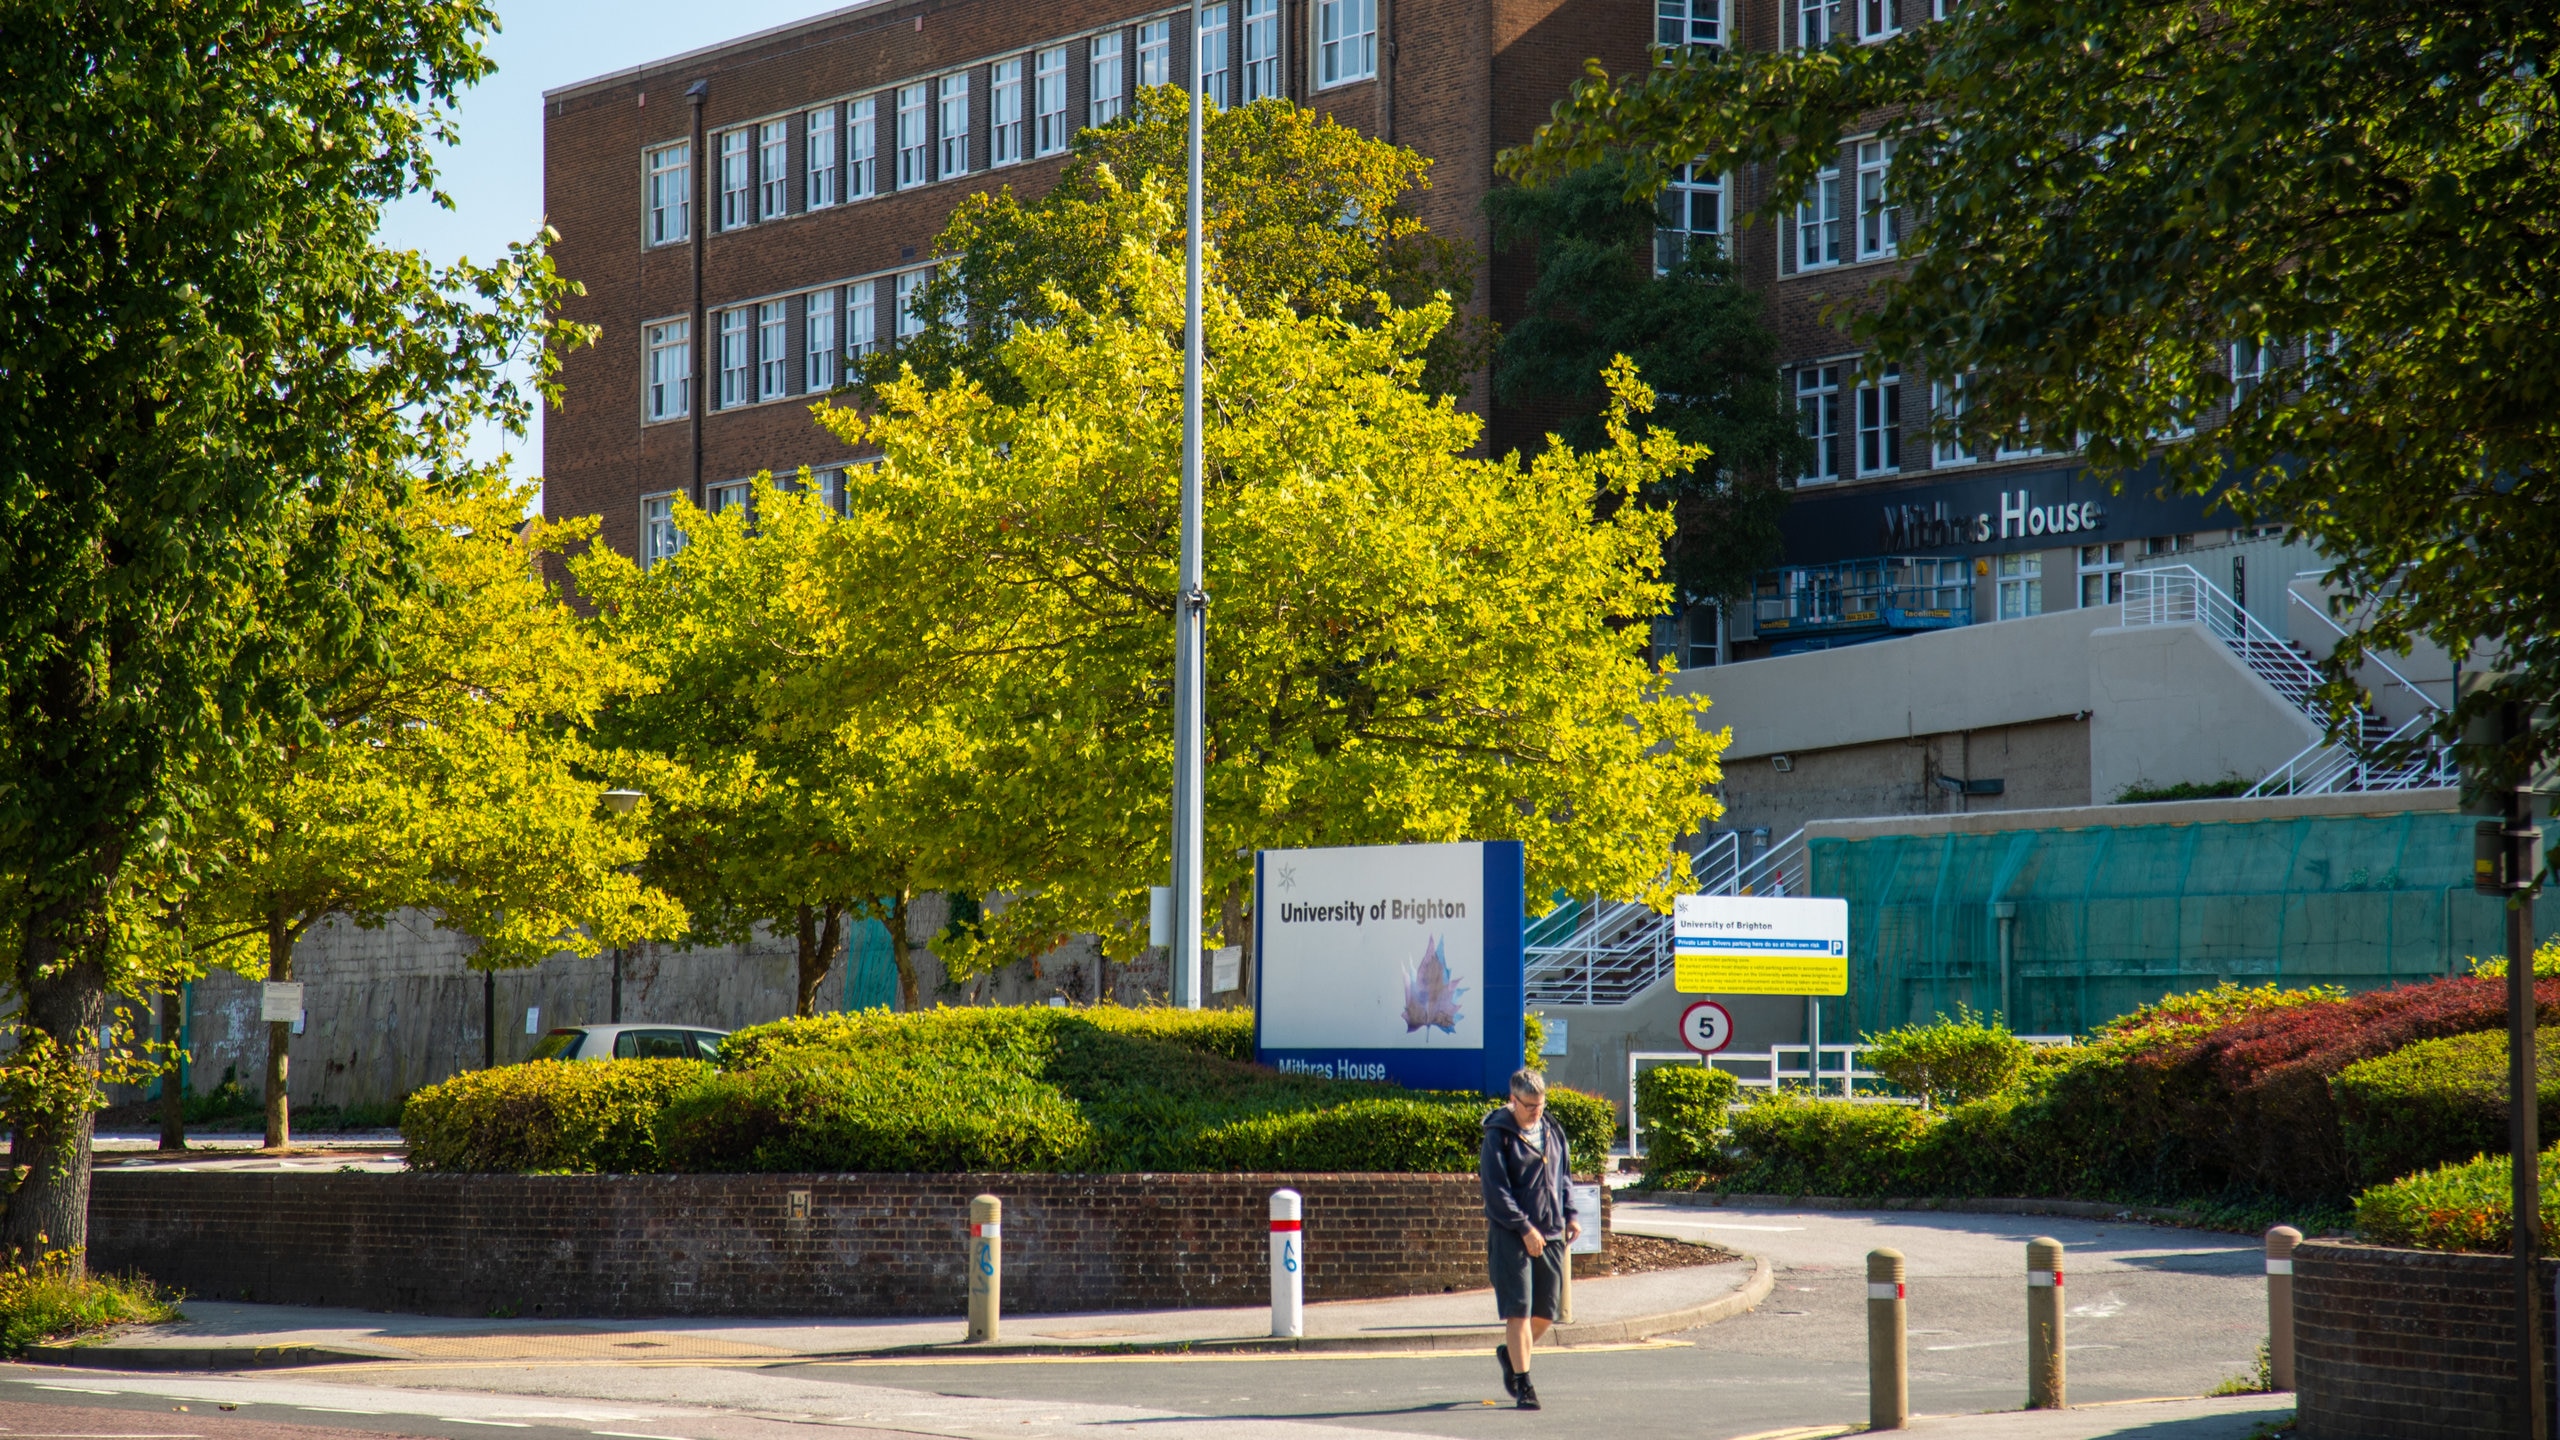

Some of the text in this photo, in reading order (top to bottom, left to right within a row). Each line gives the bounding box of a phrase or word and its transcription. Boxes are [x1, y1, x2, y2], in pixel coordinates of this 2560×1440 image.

[2001, 489, 2098, 539] House
[1281, 898, 1466, 926] University of Brighton
[1680, 920, 1773, 930] University of Brighton
[1732, 941, 1751, 949] parking
[1832, 941, 1841, 954] P
[1698, 1016, 1715, 1039] 5
[1278, 1059, 1386, 1081] Mithras House
